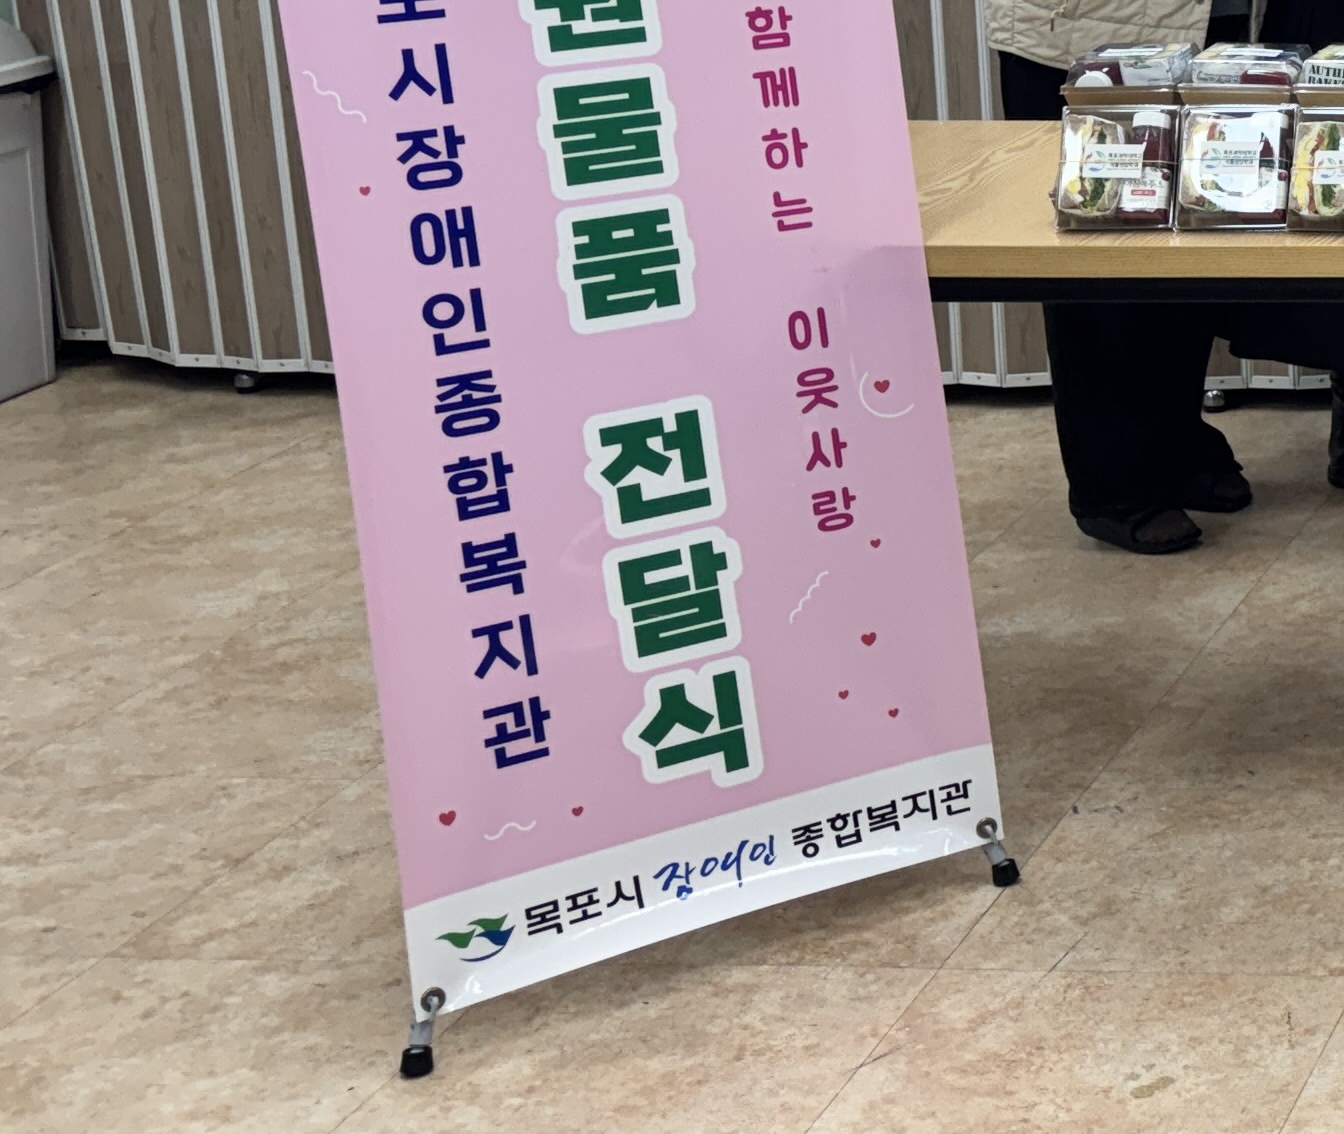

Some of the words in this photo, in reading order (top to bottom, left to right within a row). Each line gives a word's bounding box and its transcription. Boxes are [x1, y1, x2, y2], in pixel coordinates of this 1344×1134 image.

[745, 5, 814, 234] 함께하는
[786, 307, 856, 533] 이웃사랑
[600, 409, 750, 773] 전달식
[524, 874, 646, 937] 목포시
[653, 834, 777, 902] 장애인
[791, 778, 973, 859] 종합복지관
